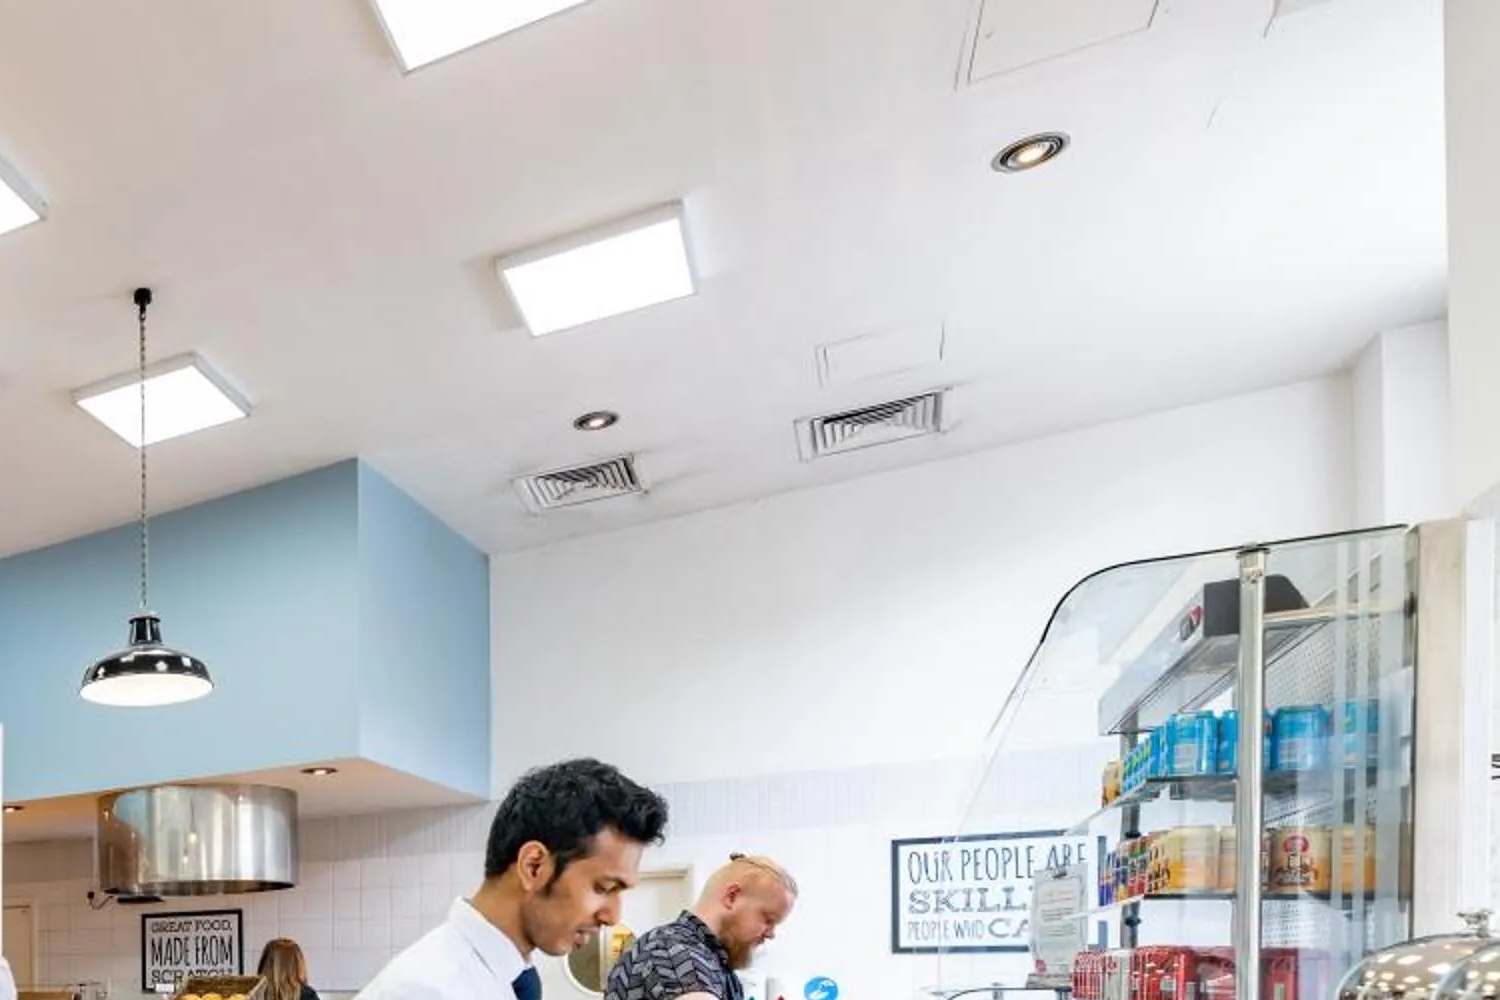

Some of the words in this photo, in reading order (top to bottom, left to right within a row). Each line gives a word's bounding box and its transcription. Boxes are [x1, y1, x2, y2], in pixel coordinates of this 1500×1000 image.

[908, 850, 953, 884] OUR
[961, 845, 1035, 881] PEOPLE
[1047, 843, 1087, 871] ARE
[908, 884, 1033, 914] SKILL
[151, 921, 192, 933] GREAT
[908, 920, 949, 941] PEOPLE
[954, 919, 984, 939] WHO
[151, 936, 191, 967] MADE
[195, 934, 233, 967] FROM
